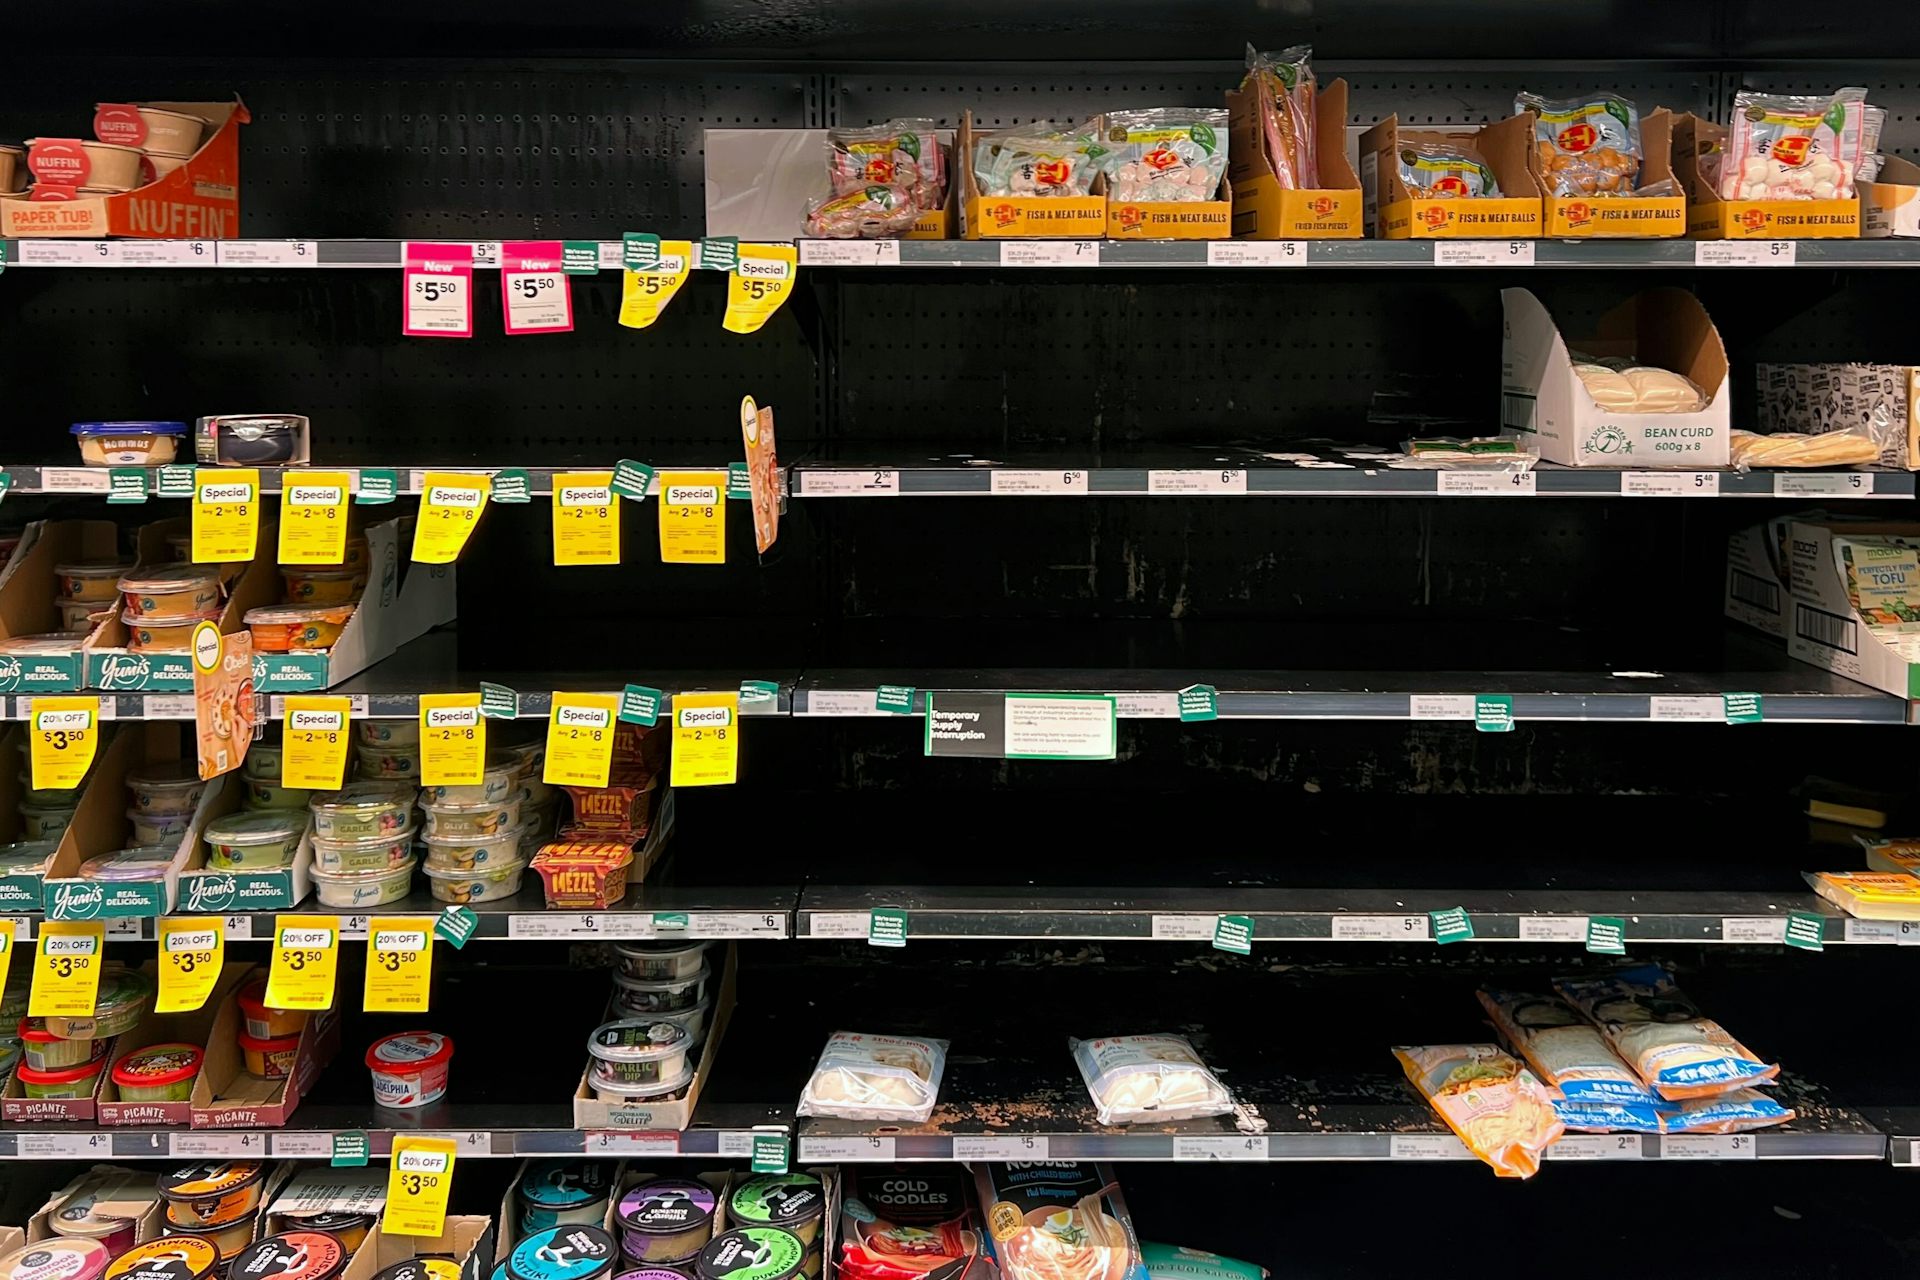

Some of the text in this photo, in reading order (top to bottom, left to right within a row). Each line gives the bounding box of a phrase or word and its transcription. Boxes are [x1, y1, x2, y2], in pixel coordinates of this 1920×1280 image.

[100, 121, 138, 133] NUFFIN
[36, 156, 81, 169] NUFFIN
[12, 210, 94, 224] PAPER TUB!
[129, 198, 225, 238] NUFFIN
[1026, 209, 1044, 221] FISH
[1054, 209, 1075, 220] MEAT
[1077, 208, 1102, 219] BALLS
[1152, 213, 1169, 224] FISH
[1180, 213, 1200, 224] MEAT
[1202, 212, 1227, 223] BALLS
[1459, 213, 1478, 224] FISH
[1488, 212, 1510, 223] MEAT
[1511, 211, 1536, 223] BALLS
[1601, 210, 1621, 221] FISH
[1631, 209, 1653, 220] MEAT
[1655, 208, 1681, 219] BALLS
[1776, 215, 1796, 226] FISH
[1806, 214, 1829, 225] MEAT
[1830, 213, 1856, 224] BALLS
[424, 260, 454, 272] New
[520, 259, 551, 271] New
[743, 262, 785, 277] Special
[1644, 426, 1714, 440] BEAN CURD
[1655, 442, 1682, 454] 600g
[1692, 441, 1701, 451] 8
[204, 486, 247, 501] Special
[295, 489, 337, 504] Special
[434, 490, 477, 505] Special
[565, 488, 608, 503] Special
[672, 488, 714, 503] Special
[215, 506, 247, 517] 2 $8
[303, 508, 336, 518] 2 $8
[442, 508, 474, 520] 2 $8
[576, 507, 608, 518] 2 $8
[681, 506, 713, 518] 2 $8
[1872, 572, 1905, 585] TOFU
[197, 642, 217, 655] Special
[163, 664, 186, 672] REAL.
[281, 665, 304, 673] REAL.
[24, 673, 70, 681] DELICIOUS.
[270, 673, 314, 681] DELICIOUS.
[43, 714, 85, 724] 20% OFF
[296, 713, 338, 725] Special
[431, 711, 473, 723] Special
[563, 709, 604, 722] Special
[685, 711, 726, 723] Special
[931, 710, 980, 722] Temporary
[931, 720, 963, 731] Supply
[305, 732, 337, 743] 2 $8
[442, 729, 474, 740] 2 $8
[570, 729, 602, 741] 2 $8
[695, 729, 726, 740] 2 $8
[931, 730, 986, 741] Interruption
[581, 794, 622, 815] MEZZE
[340, 825, 373, 834] GARLIC
[443, 821, 470, 831] OLIVE
[349, 857, 382, 867] GARLIC
[552, 872, 596, 893] MEZZE
[117, 890, 141, 898] REAL.
[240, 889, 284, 897] DELICIOUS.
[106, 897, 151, 906] DELICIOUS.
[51, 940, 92, 949] 20% OFF
[172, 935, 212, 945] 20% OFF
[283, 934, 324, 943] 20% OFF
[378, 935, 418, 944] 20% OFF
[614, 1062, 653, 1073] GARLIC
[624, 1073, 641, 1081] DIP
[26, 1103, 67, 1115] PICANTE
[123, 1107, 166, 1119] PICANTE
[215, 1111, 258, 1123] PICANTE
[402, 1156, 443, 1167] 20% OFF
[1008, 1170, 1082, 1183] WITH CHILLED BROTH
[882, 1180, 929, 1192] COLD
[868, 1193, 949, 1205] NOODLES
